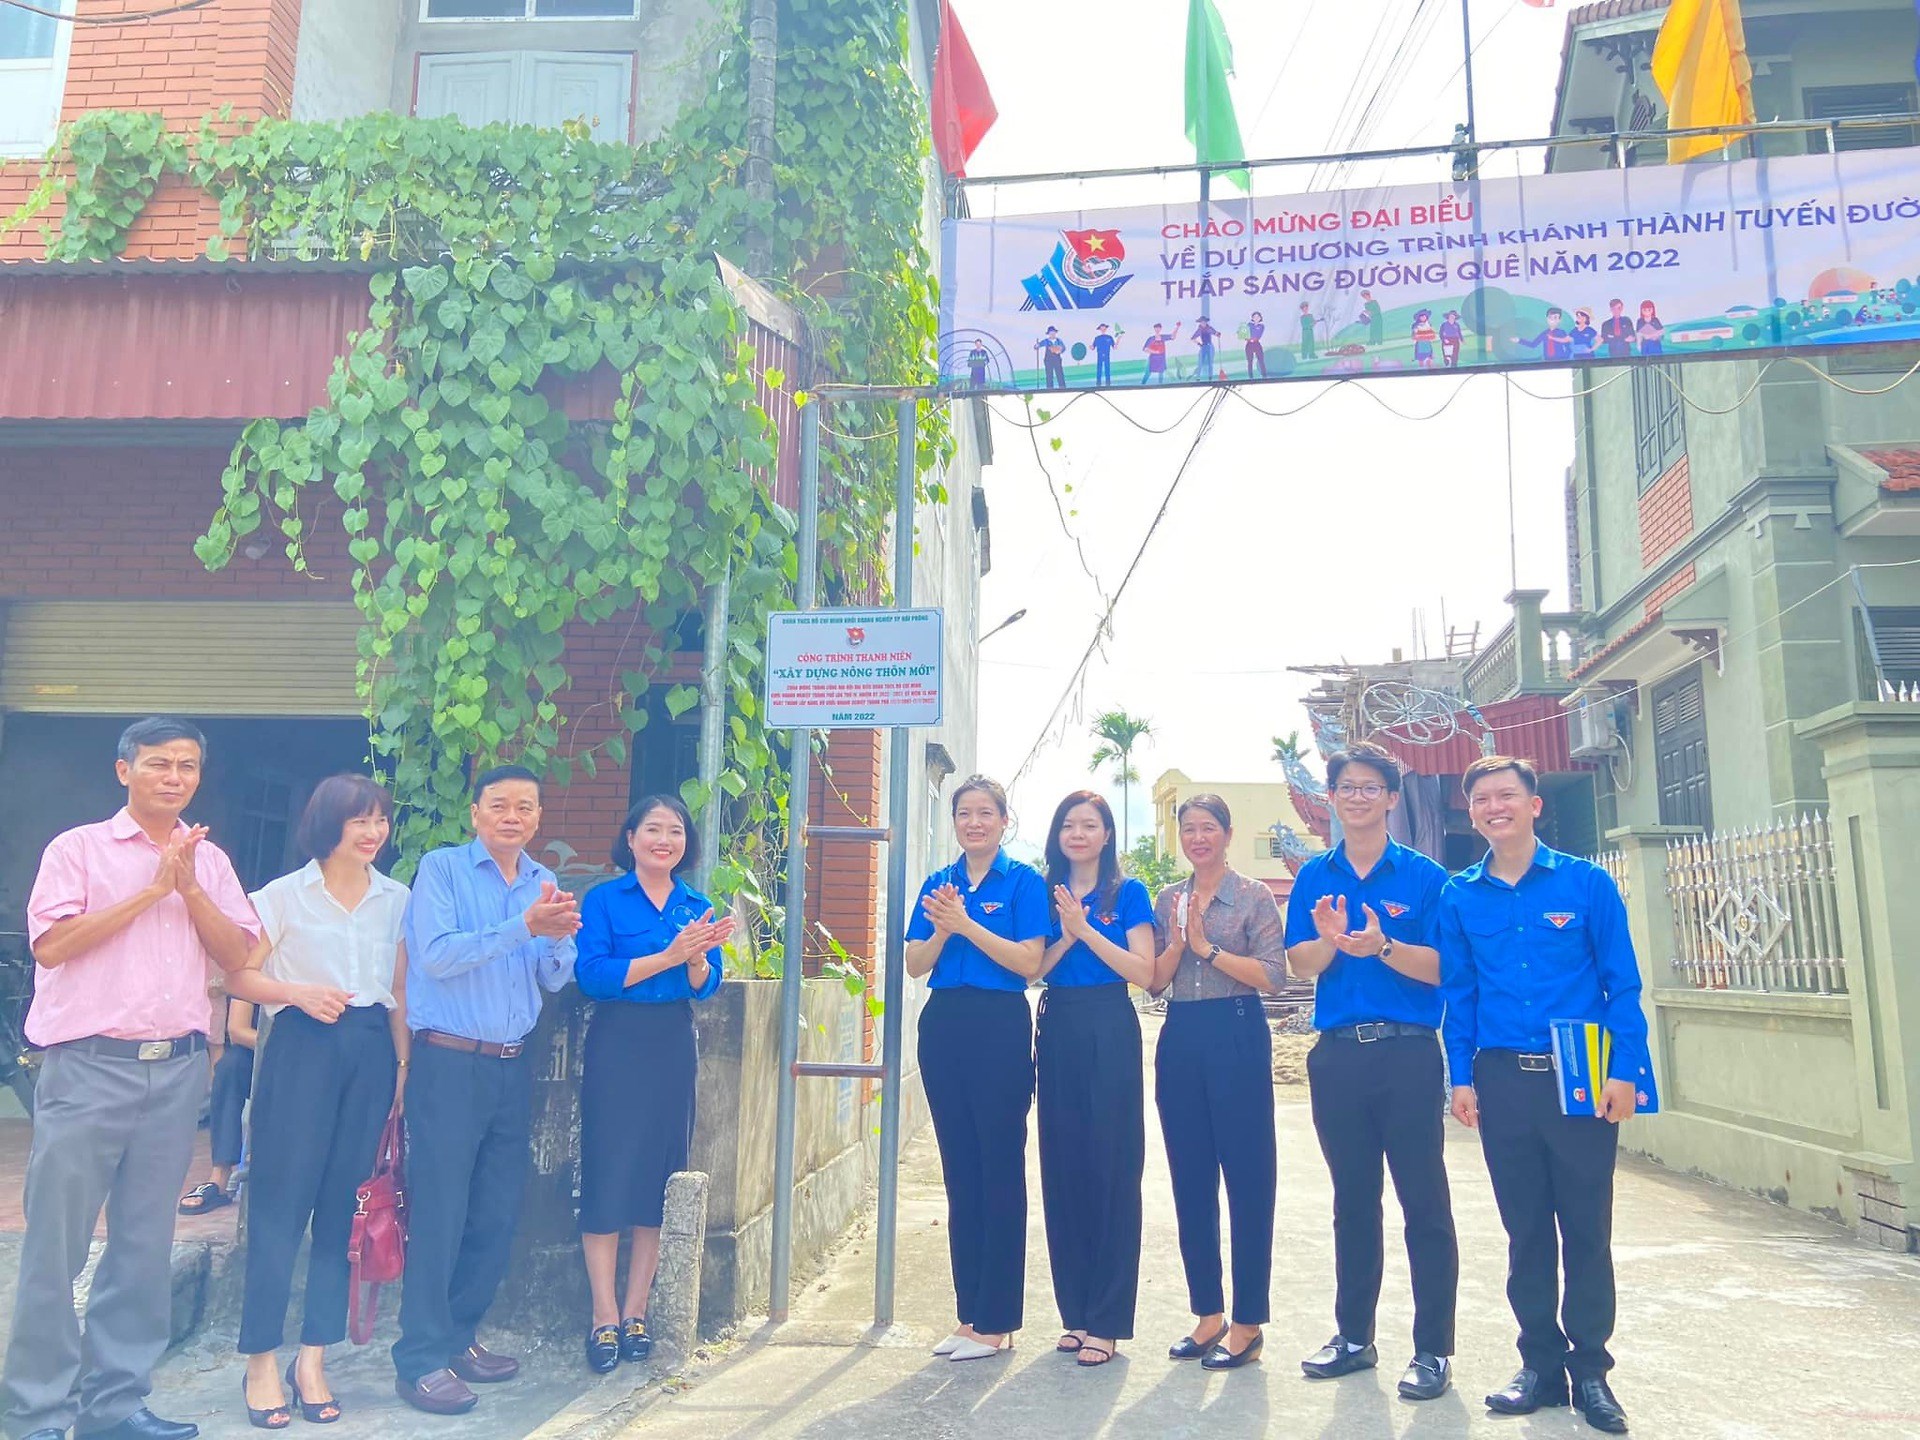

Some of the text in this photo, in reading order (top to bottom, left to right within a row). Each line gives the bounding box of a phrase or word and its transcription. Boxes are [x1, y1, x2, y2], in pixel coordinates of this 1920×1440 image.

[1161, 194, 1474, 239] CHÀO MỪNG ĐẠI BIỂU
[1160, 245, 1195, 270] VỀ
[1206, 247, 1247, 270] DỰ
[1254, 240, 1390, 264] CHƯƠNG
[1398, 231, 1489, 253] TRÌNH
[1499, 222, 1607, 245] KHÁNH
[1616, 211, 1725, 237] THÀNH
[1735, 199, 1836, 230] TUYẾN
[1160, 248, 1681, 299] THẮP SÁNG ĐƯỜNG QUÊ NĂM 2022
[856, 652, 887, 661] THANH
[806, 667, 838, 680] DỰNG
[841, 665, 873, 678] NÔNG
[875, 664, 906, 677] THÔN
[854, 712, 876, 721] 2022
